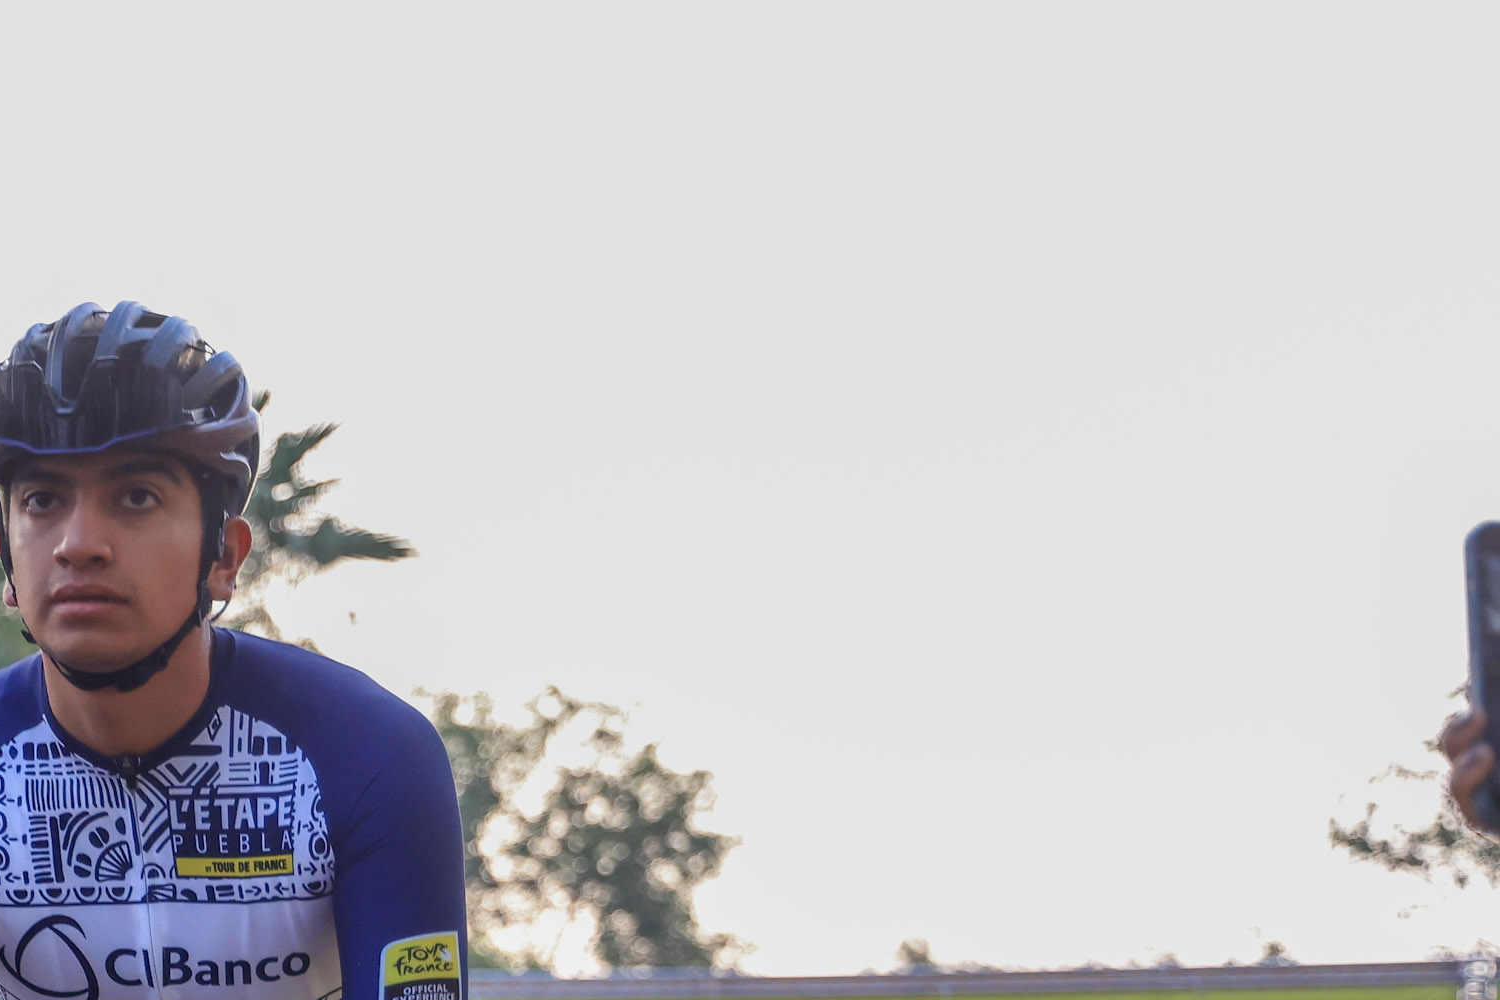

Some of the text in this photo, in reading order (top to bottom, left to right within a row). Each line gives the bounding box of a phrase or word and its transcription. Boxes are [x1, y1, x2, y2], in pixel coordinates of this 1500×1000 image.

[172, 830, 293, 854] PUEBLA
[212, 861, 235, 873] TOUR
[238, 861, 250, 873] DE
[253, 859, 287, 872] FRANCE
[403, 983, 449, 996] OFFICIAL
